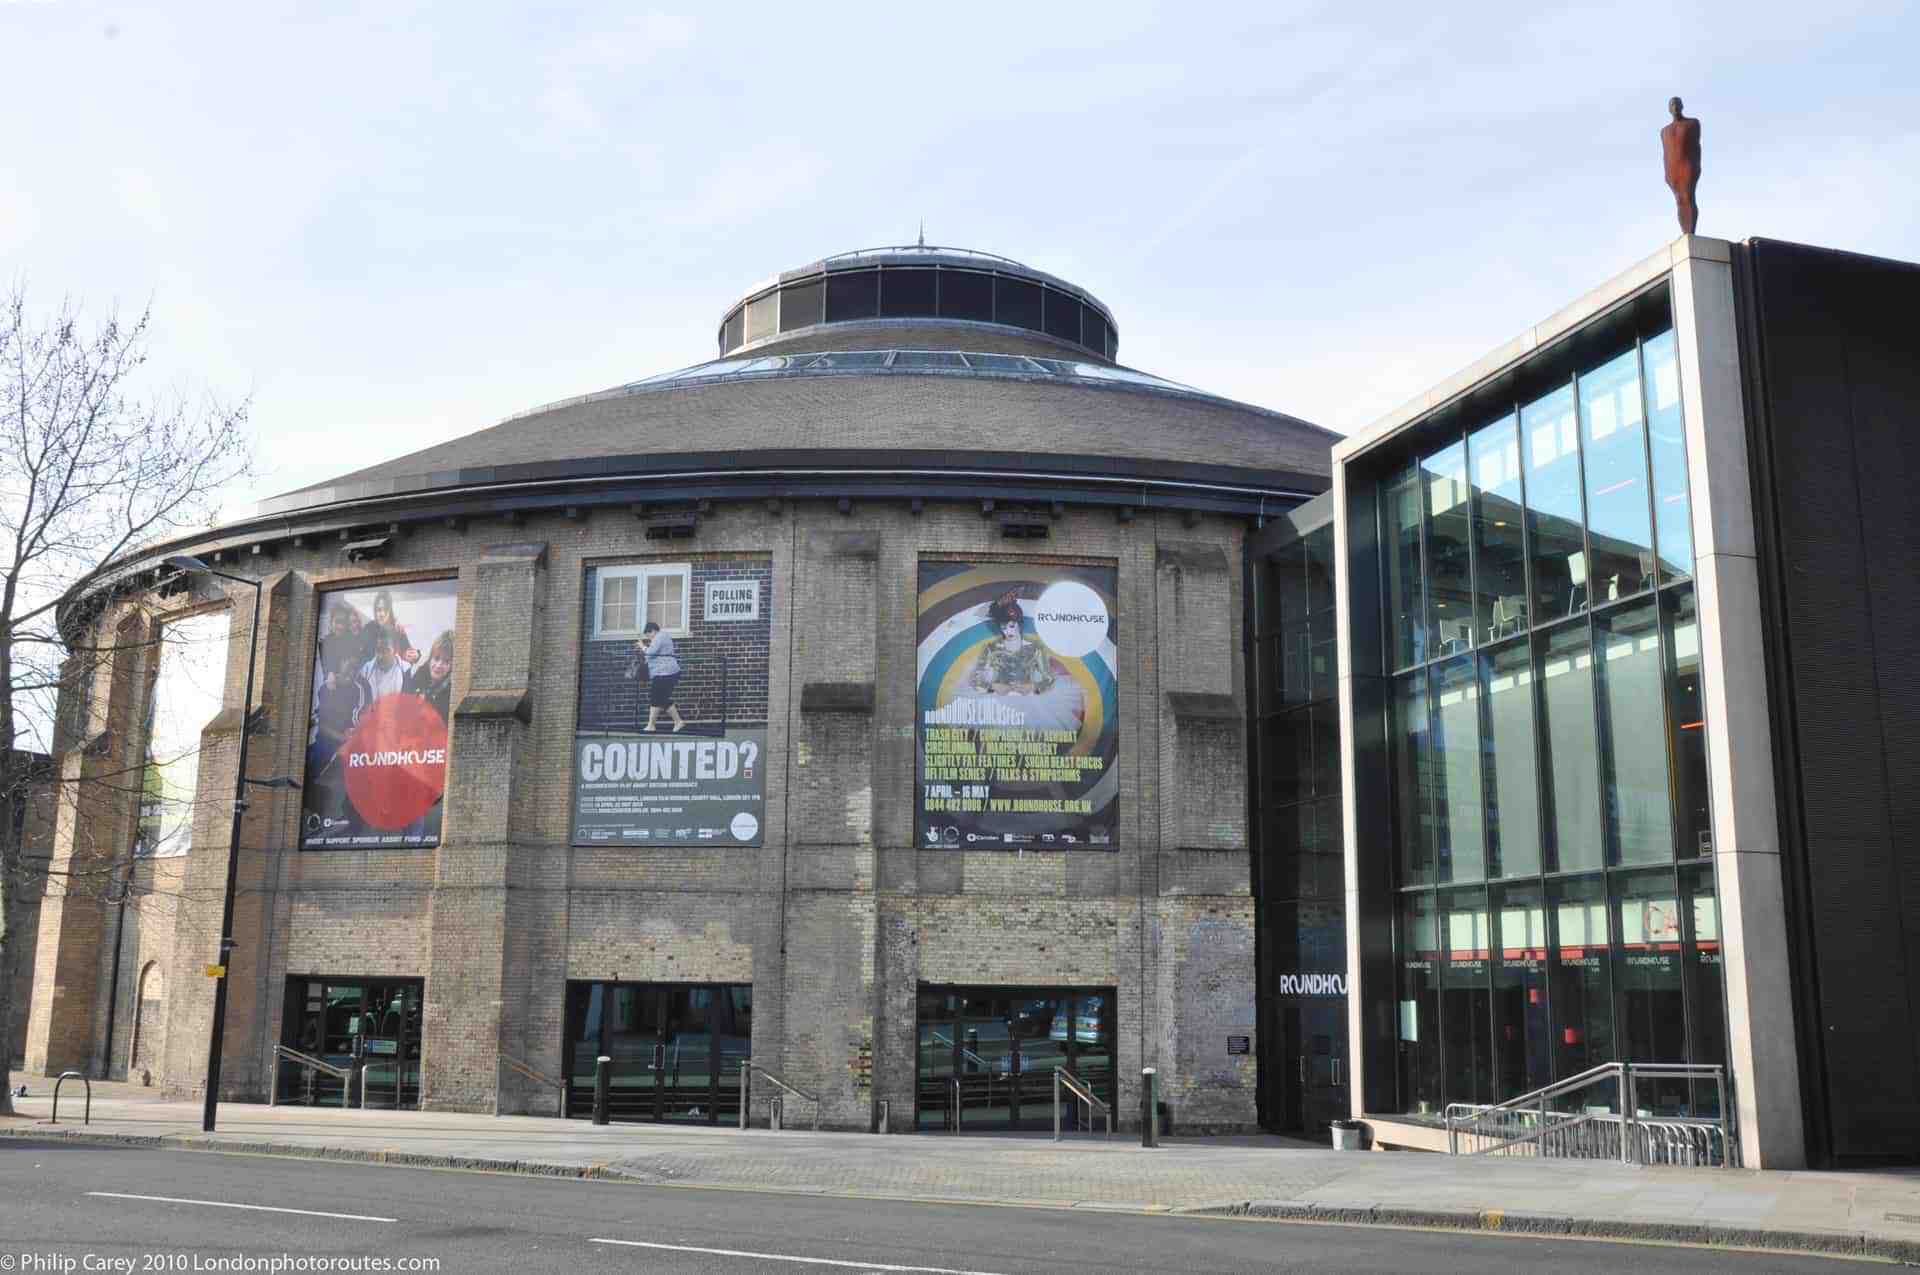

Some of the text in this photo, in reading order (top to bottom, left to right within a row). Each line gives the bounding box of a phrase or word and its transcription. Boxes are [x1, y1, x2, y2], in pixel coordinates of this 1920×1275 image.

[712, 589, 752, 600] POLLING
[712, 603, 752, 613] STATION
[1038, 613, 1105, 624] ROUNDHOUSE
[349, 749, 446, 768] ROUNDHOUSE
[581, 740, 758, 781] COUNTED?
[963, 755, 977, 767] FAT
[930, 785, 952, 798] APRIL
[971, 785, 990, 798] MAY
